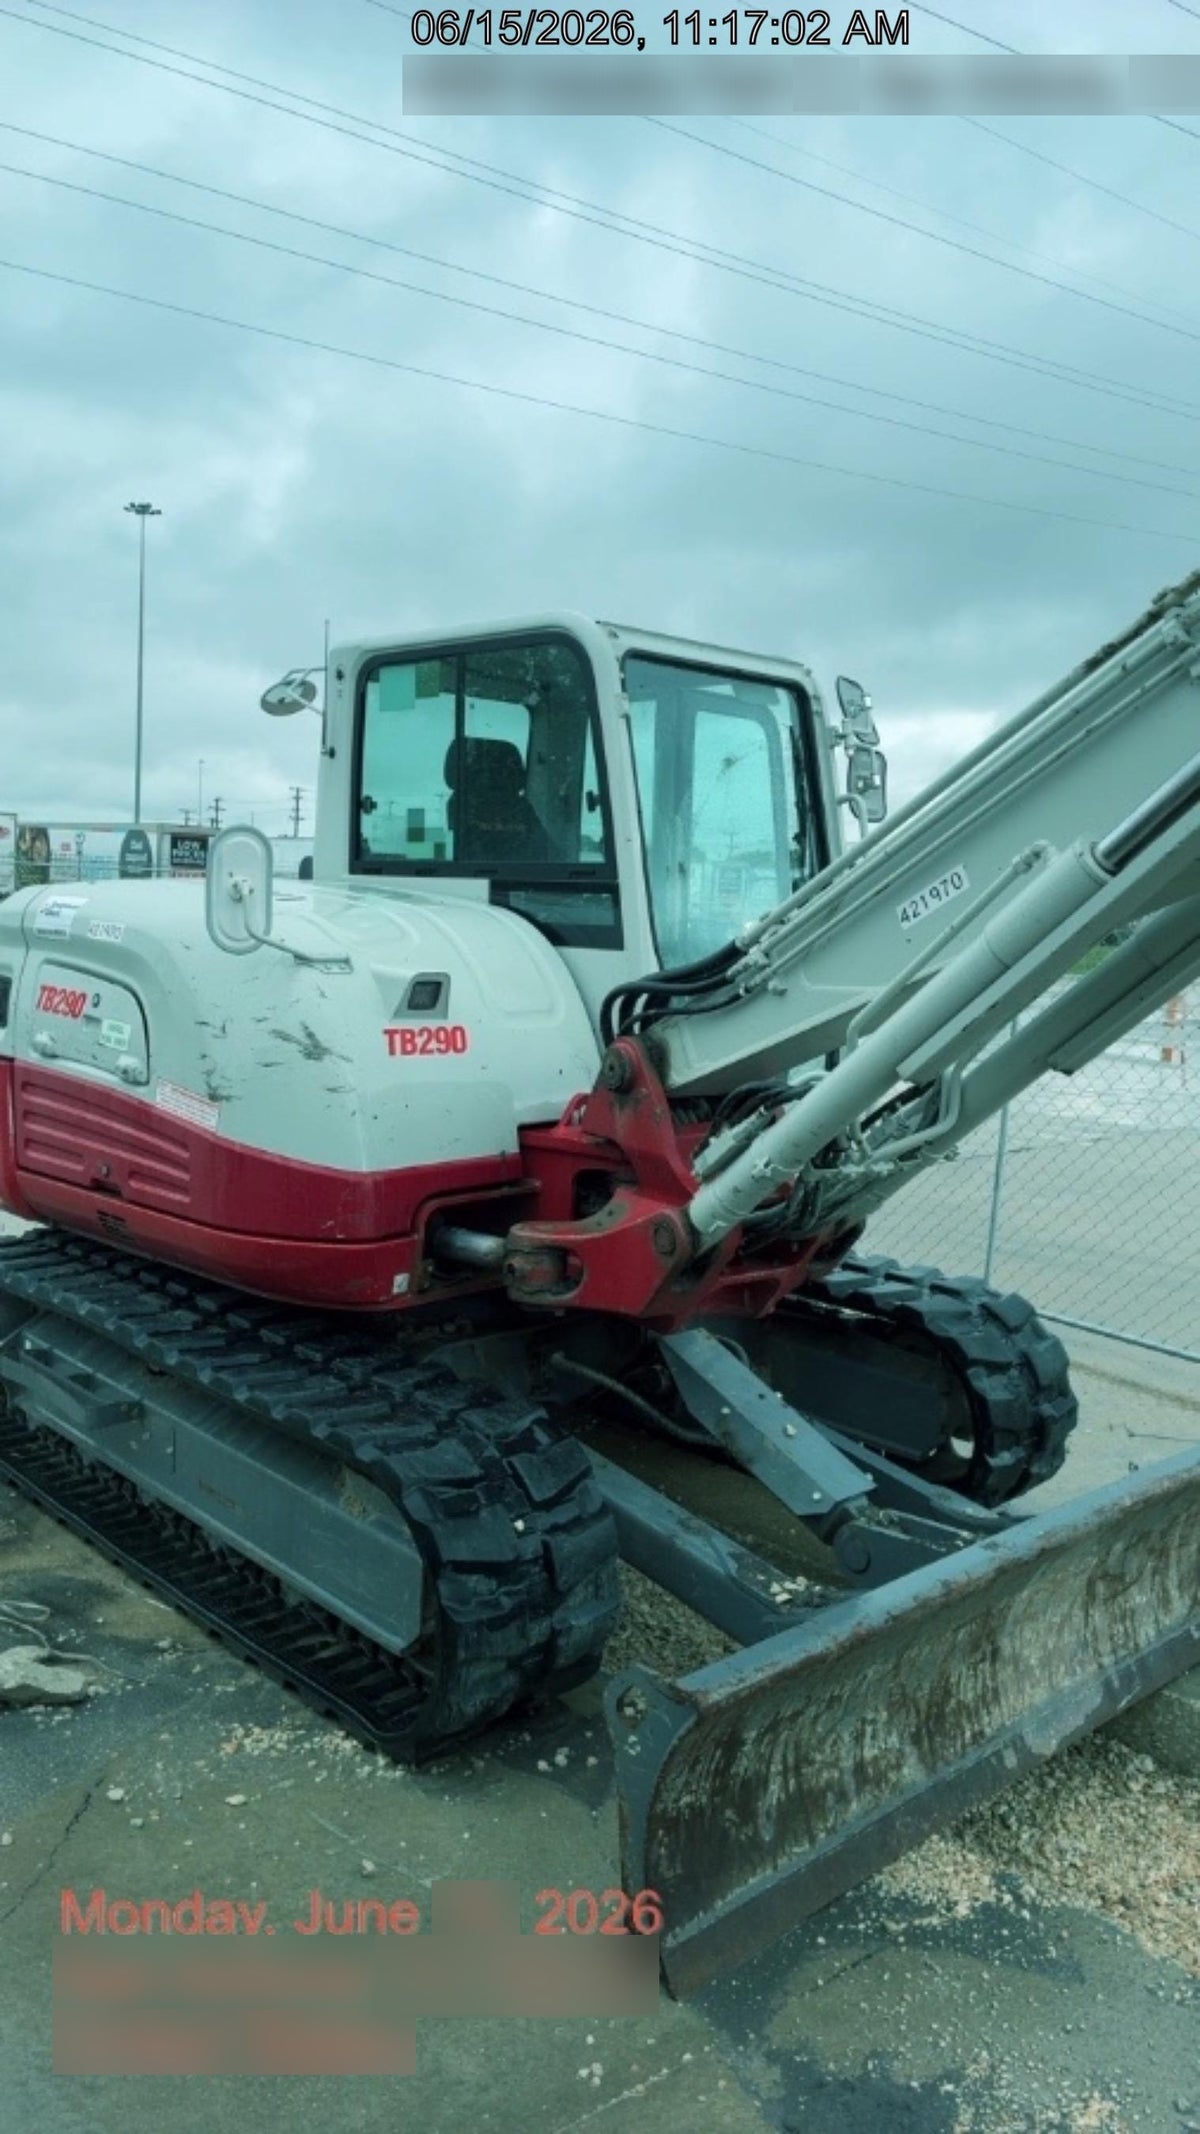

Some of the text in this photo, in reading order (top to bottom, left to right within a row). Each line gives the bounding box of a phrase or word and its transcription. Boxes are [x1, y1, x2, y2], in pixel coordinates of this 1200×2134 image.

[901, 871, 964, 923] 421970
[36, 985, 87, 1018] TB290
[383, 1026, 468, 1056] TB290
